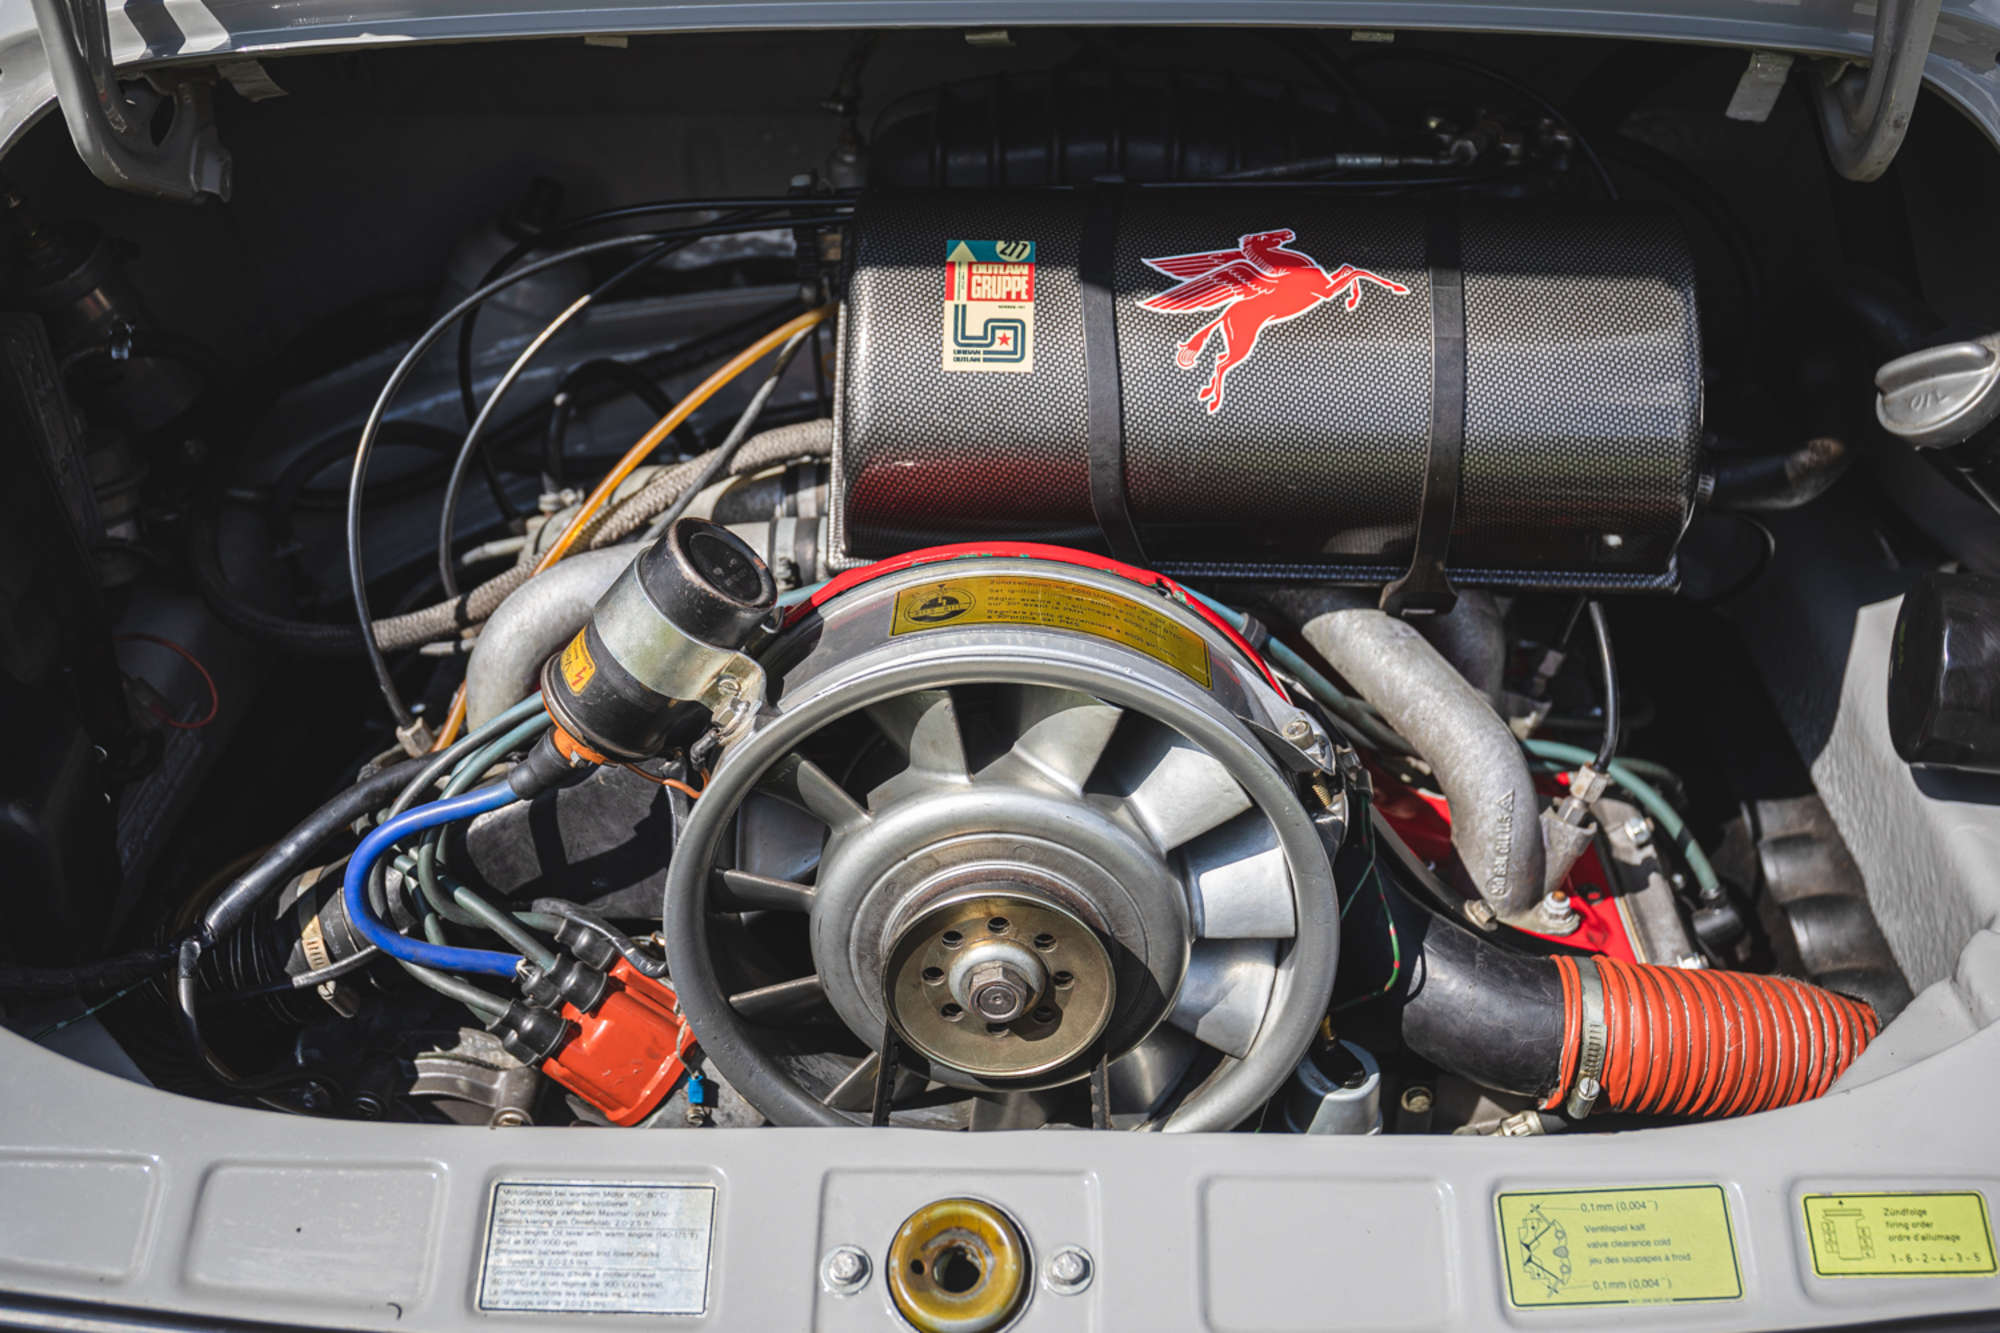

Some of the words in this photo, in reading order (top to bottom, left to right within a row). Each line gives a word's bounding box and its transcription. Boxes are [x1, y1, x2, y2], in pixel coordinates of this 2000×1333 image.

[999, 240, 1028, 259] 277
[972, 263, 1029, 275] OUTLAW
[971, 275, 1029, 299] GRUPPE
[1584, 1224, 1626, 1234] Ventilspiel
[1630, 1223, 1645, 1232] kalt
[1886, 1220, 1909, 1230] firing
[1911, 1220, 1933, 1228] order
[1586, 1240, 1610, 1249] valve
[1613, 1239, 1651, 1248] clearance
[1653, 1237, 1671, 1246] cold
[1888, 1233, 1911, 1241] ordre
[1604, 1254, 1620, 1264] des
[1622, 1254, 1662, 1266] soupapes
[1674, 1252, 1691, 1262] froid
